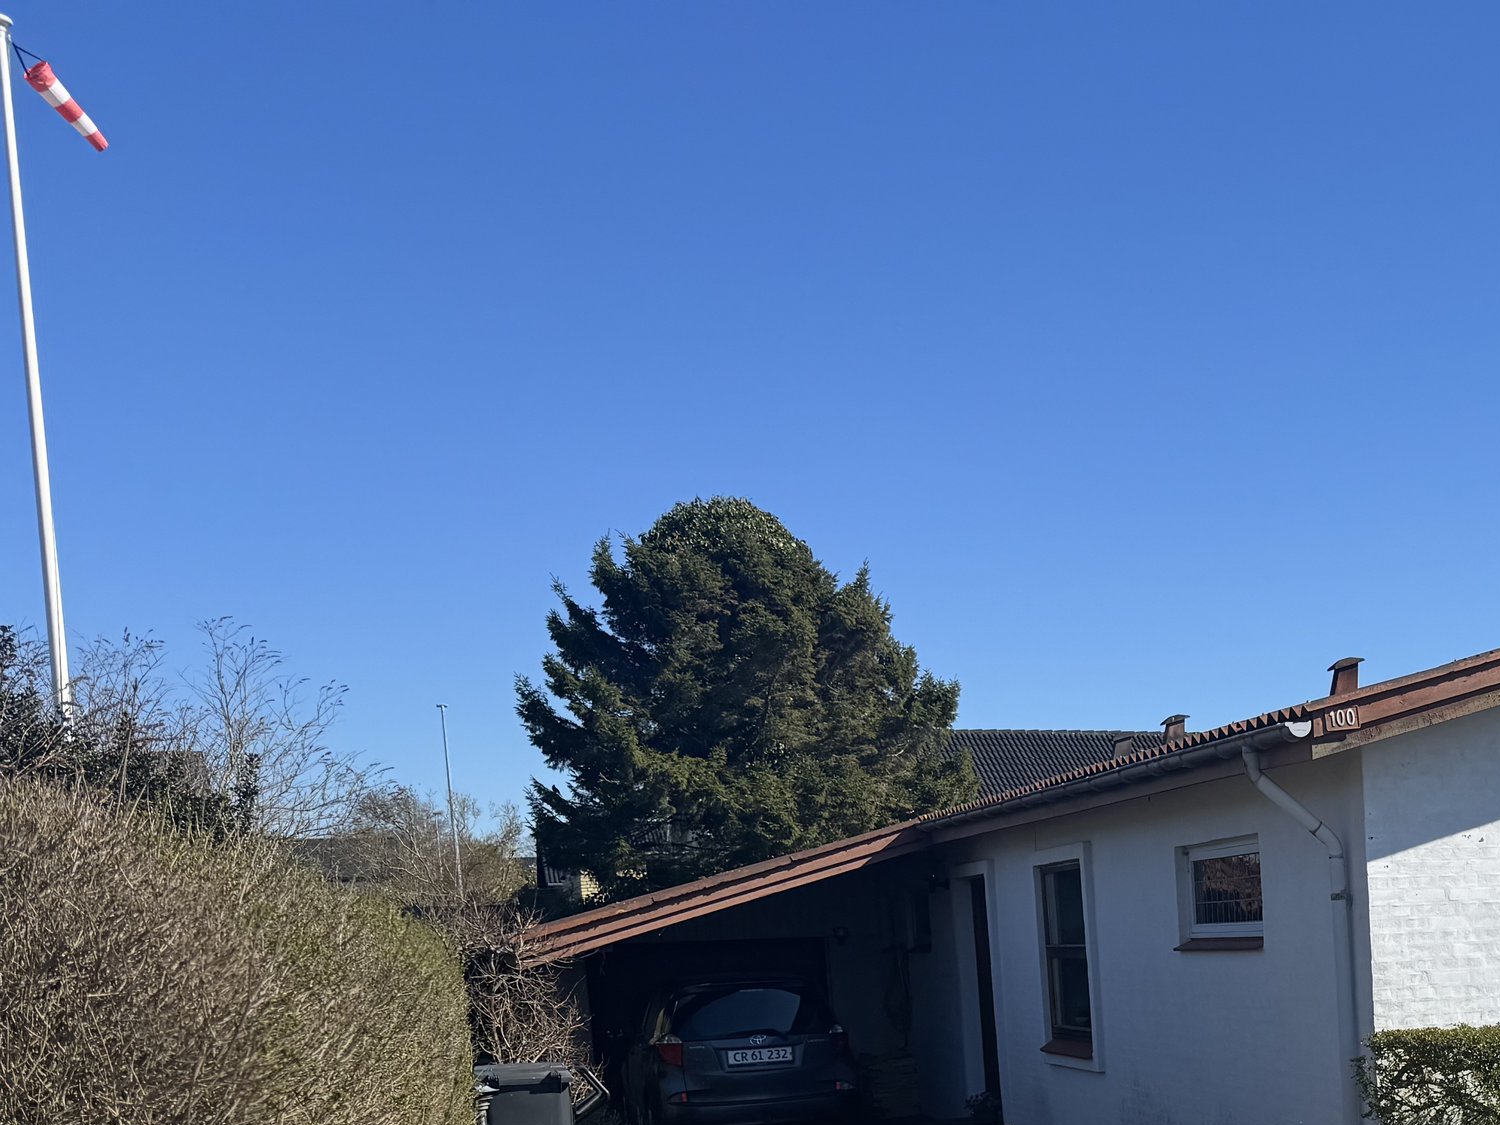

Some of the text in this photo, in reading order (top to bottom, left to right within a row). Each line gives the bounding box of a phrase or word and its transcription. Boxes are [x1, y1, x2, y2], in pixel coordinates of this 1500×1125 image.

[1329, 708, 1356, 727] 100
[733, 1049, 788, 1063] CR 61 232
